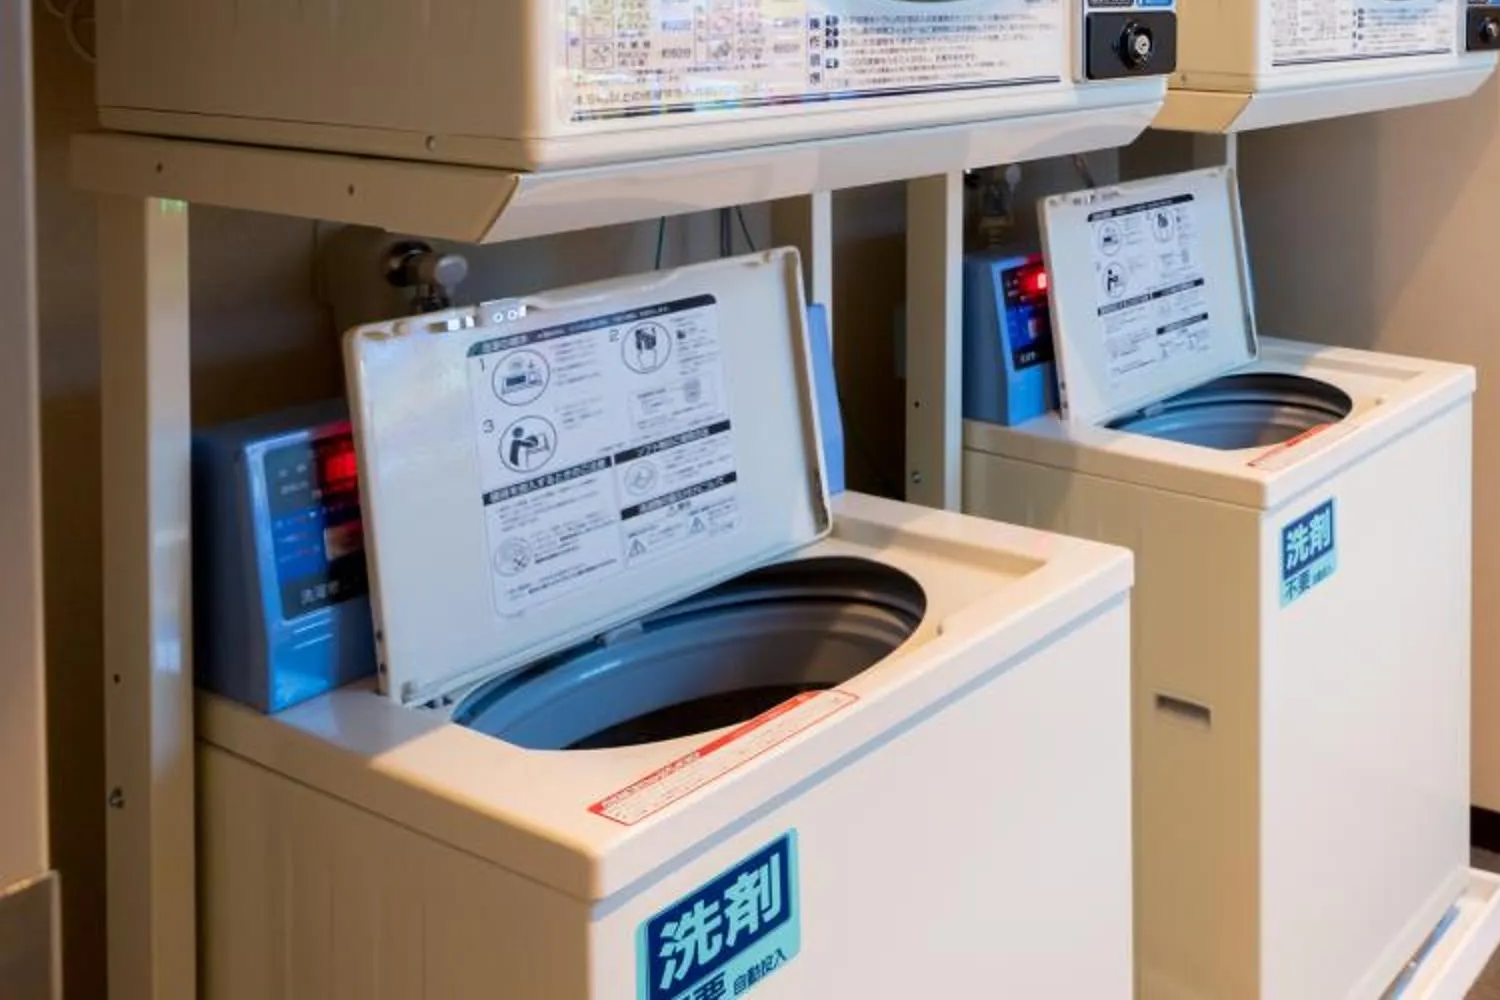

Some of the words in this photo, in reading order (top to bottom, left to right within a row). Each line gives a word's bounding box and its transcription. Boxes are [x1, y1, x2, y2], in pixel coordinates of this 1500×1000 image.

[483, 419, 495, 433] 3
[1286, 507, 1331, 570] 洗剤
[659, 852, 782, 990] 洗剤
